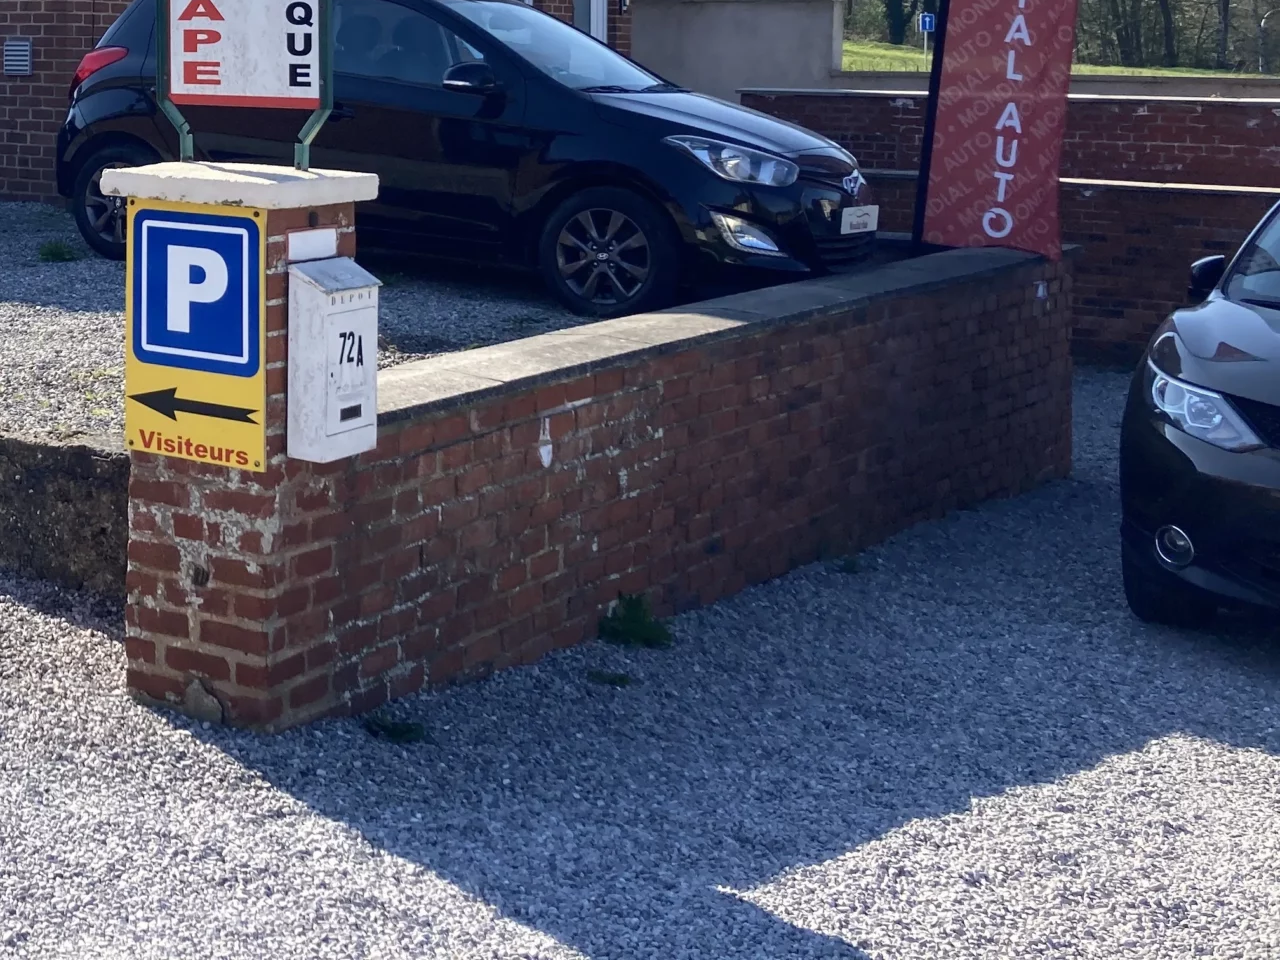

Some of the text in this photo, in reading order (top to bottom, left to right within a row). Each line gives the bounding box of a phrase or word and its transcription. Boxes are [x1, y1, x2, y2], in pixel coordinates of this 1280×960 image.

[982, 102, 1023, 238] AUTO
[167, 244, 229, 333] P
[339, 331, 363, 367] 72A
[139, 429, 248, 466] Visiteurs
